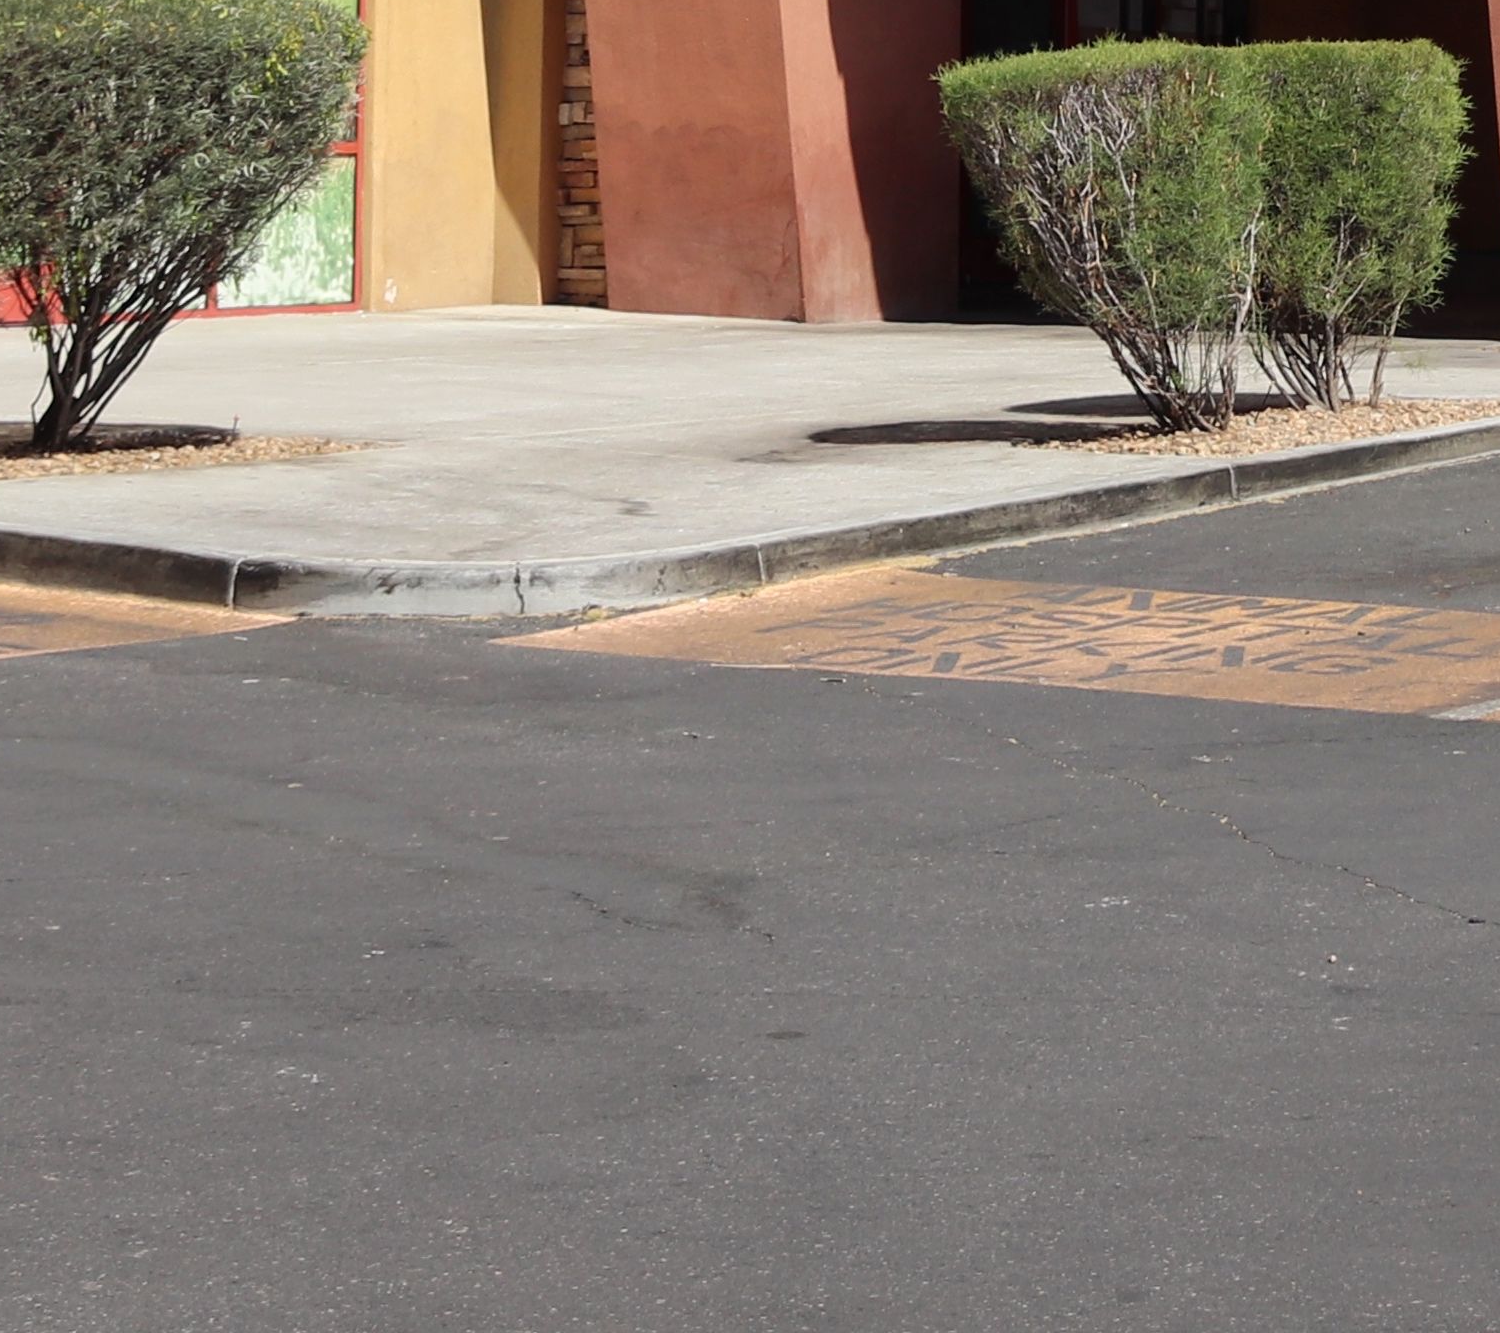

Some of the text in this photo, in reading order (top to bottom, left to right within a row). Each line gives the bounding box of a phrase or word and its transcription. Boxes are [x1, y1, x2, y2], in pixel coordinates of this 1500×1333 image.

[820, 598, 1494, 660] HOSPITAL
[1012, 587, 1450, 630] ANIMAL
[756, 618, 1398, 675] PARKING
[786, 646, 1196, 682] ONLY
